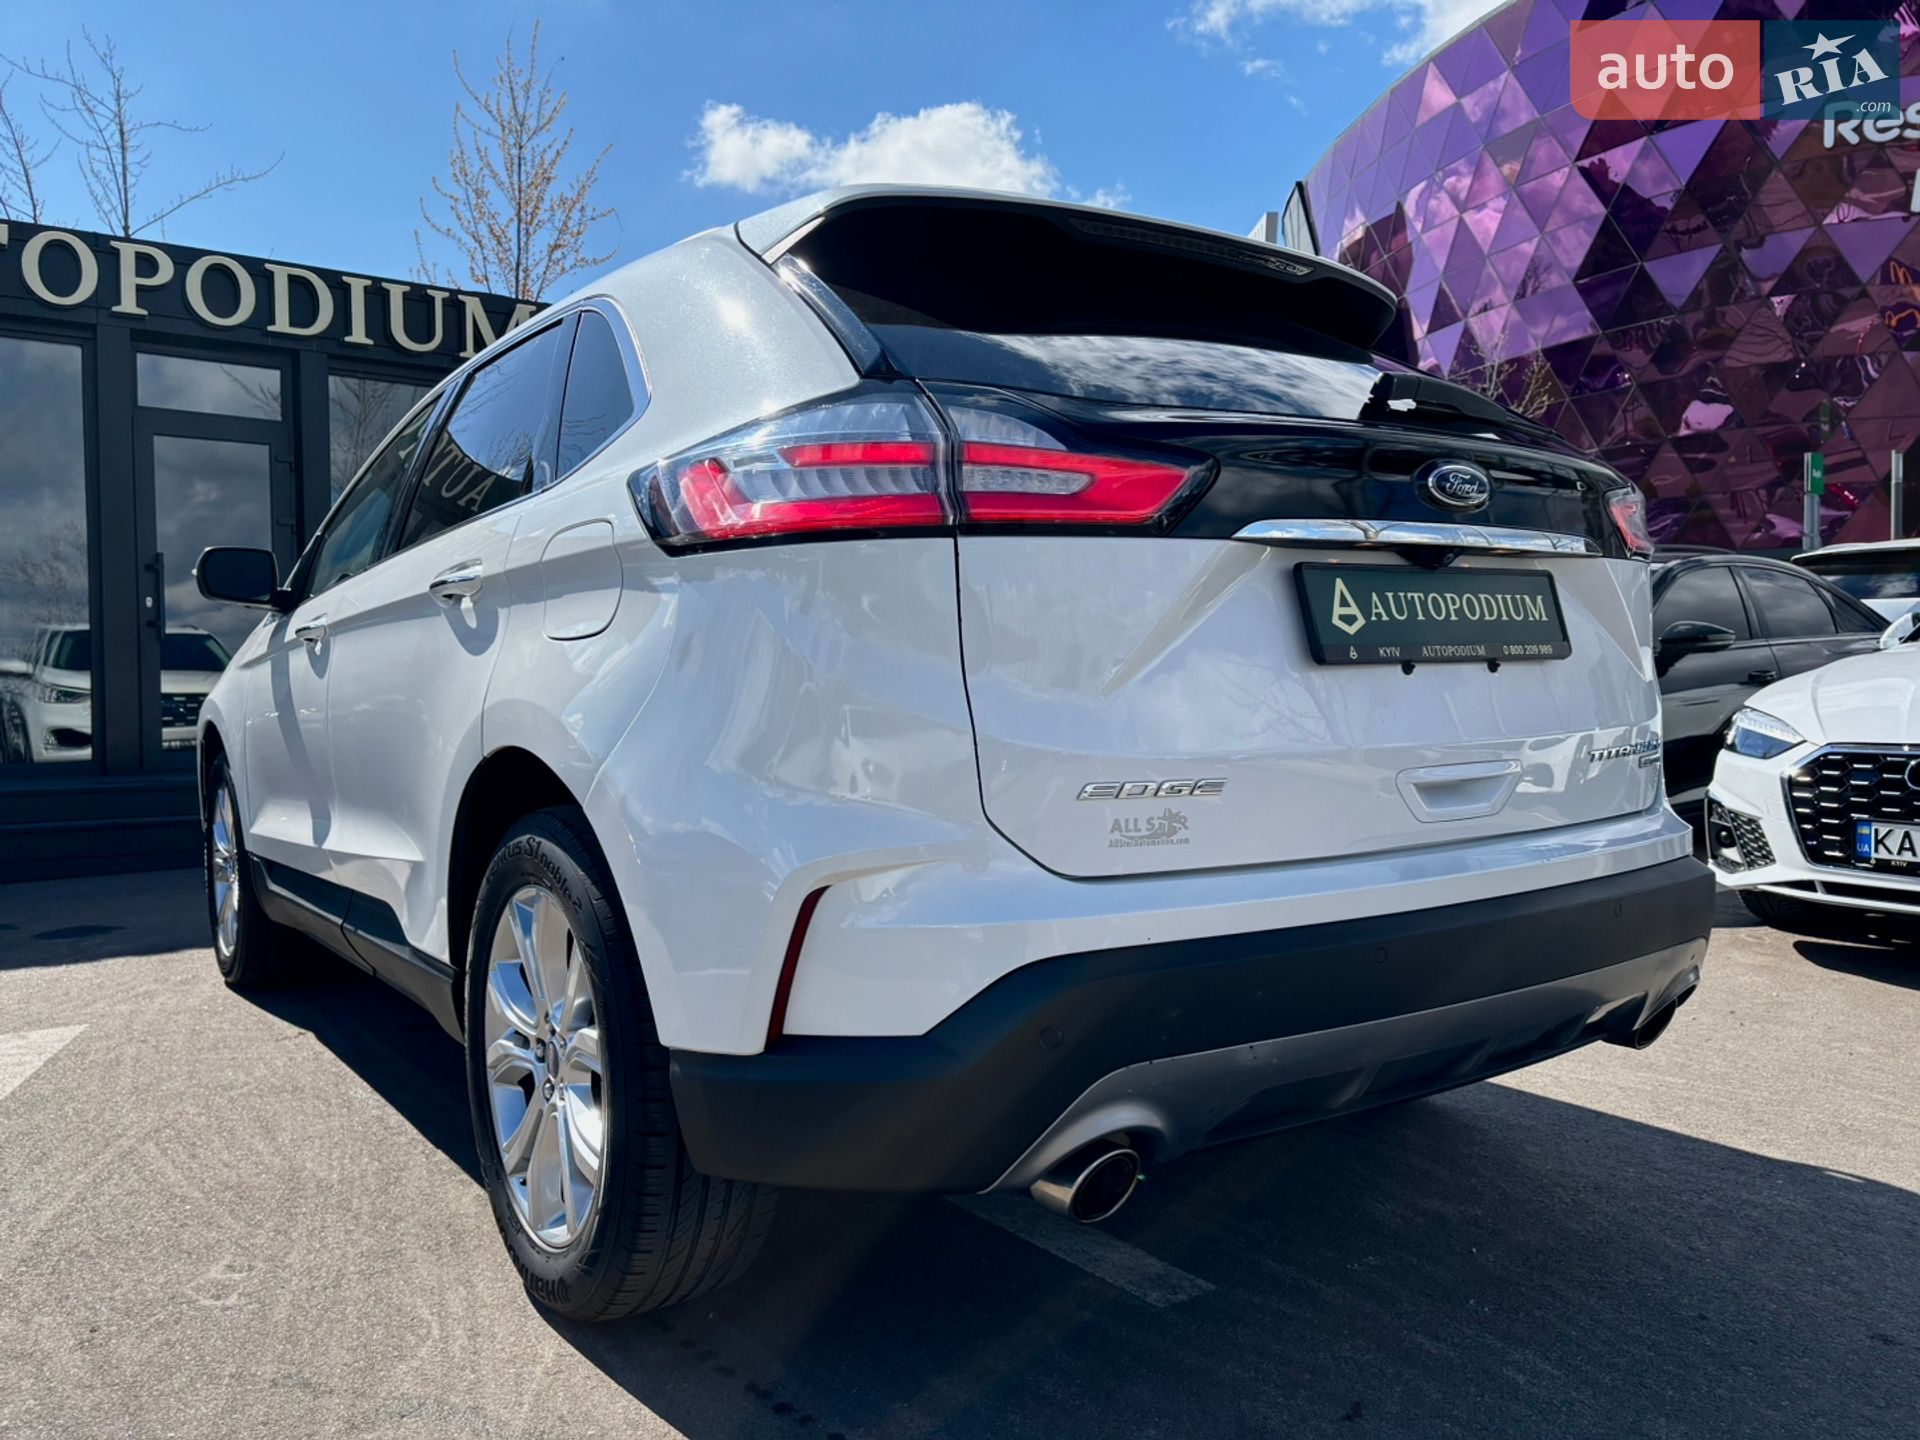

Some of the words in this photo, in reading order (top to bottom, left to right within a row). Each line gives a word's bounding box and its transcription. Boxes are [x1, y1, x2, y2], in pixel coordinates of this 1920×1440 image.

[0, 222, 537, 359] OPODIUM
[1445, 472, 1479, 497] Ford
[1370, 591, 1549, 622] AUTOPODIUM
[1421, 645, 1487, 658] AUTOPODIUM
[1076, 778, 1229, 801] EDGE
[1109, 817, 1142, 834] ALL
[1873, 827, 1918, 857] KA
